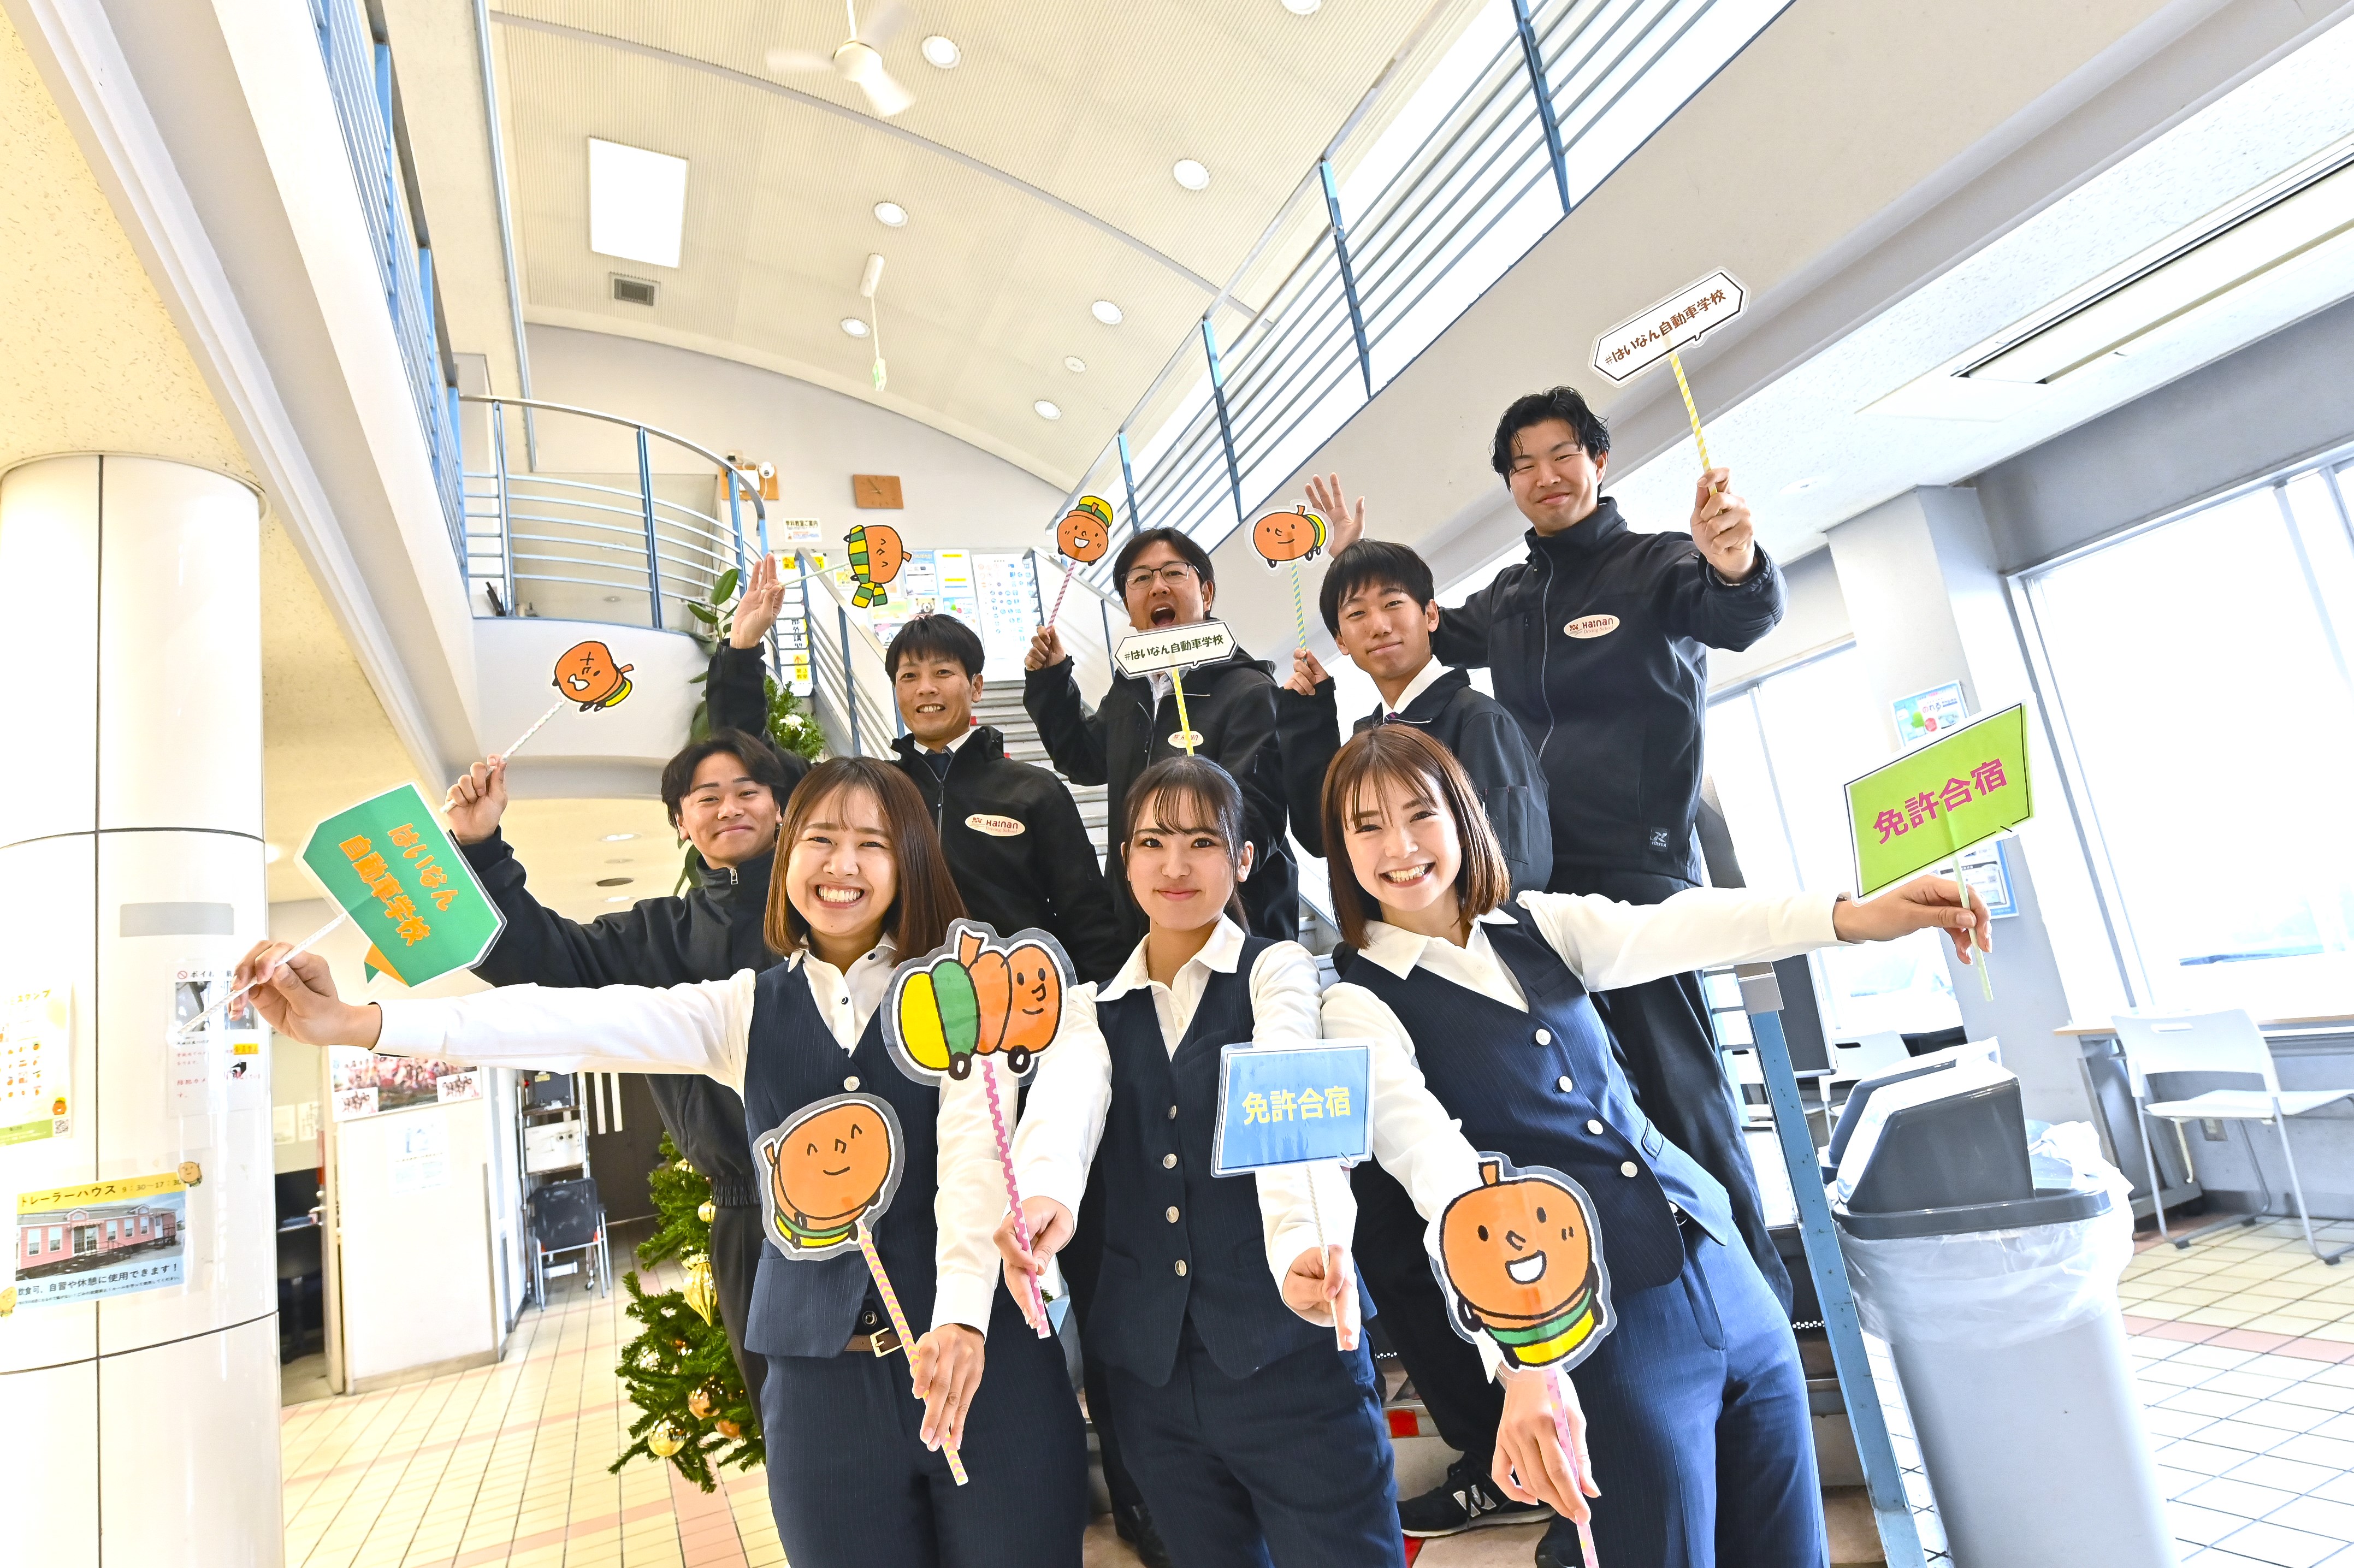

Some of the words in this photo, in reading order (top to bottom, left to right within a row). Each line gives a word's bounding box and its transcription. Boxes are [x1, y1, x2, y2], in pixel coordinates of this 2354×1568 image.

[1605, 289, 1726, 365] #はいなん自動車学校
[1582, 618, 1613, 629] Hainan
[1124, 634, 1225, 661] #はいなん自動車学校
[1873, 758, 2007, 844] 免許合宿
[986, 819, 1018, 829] Hainan
[387, 823, 458, 912] はいなん
[338, 834, 431, 946] 自動車学校
[1241, 1085, 1351, 1126] 免許合宿
[21, 1185, 116, 1206] トレーラーハウス
